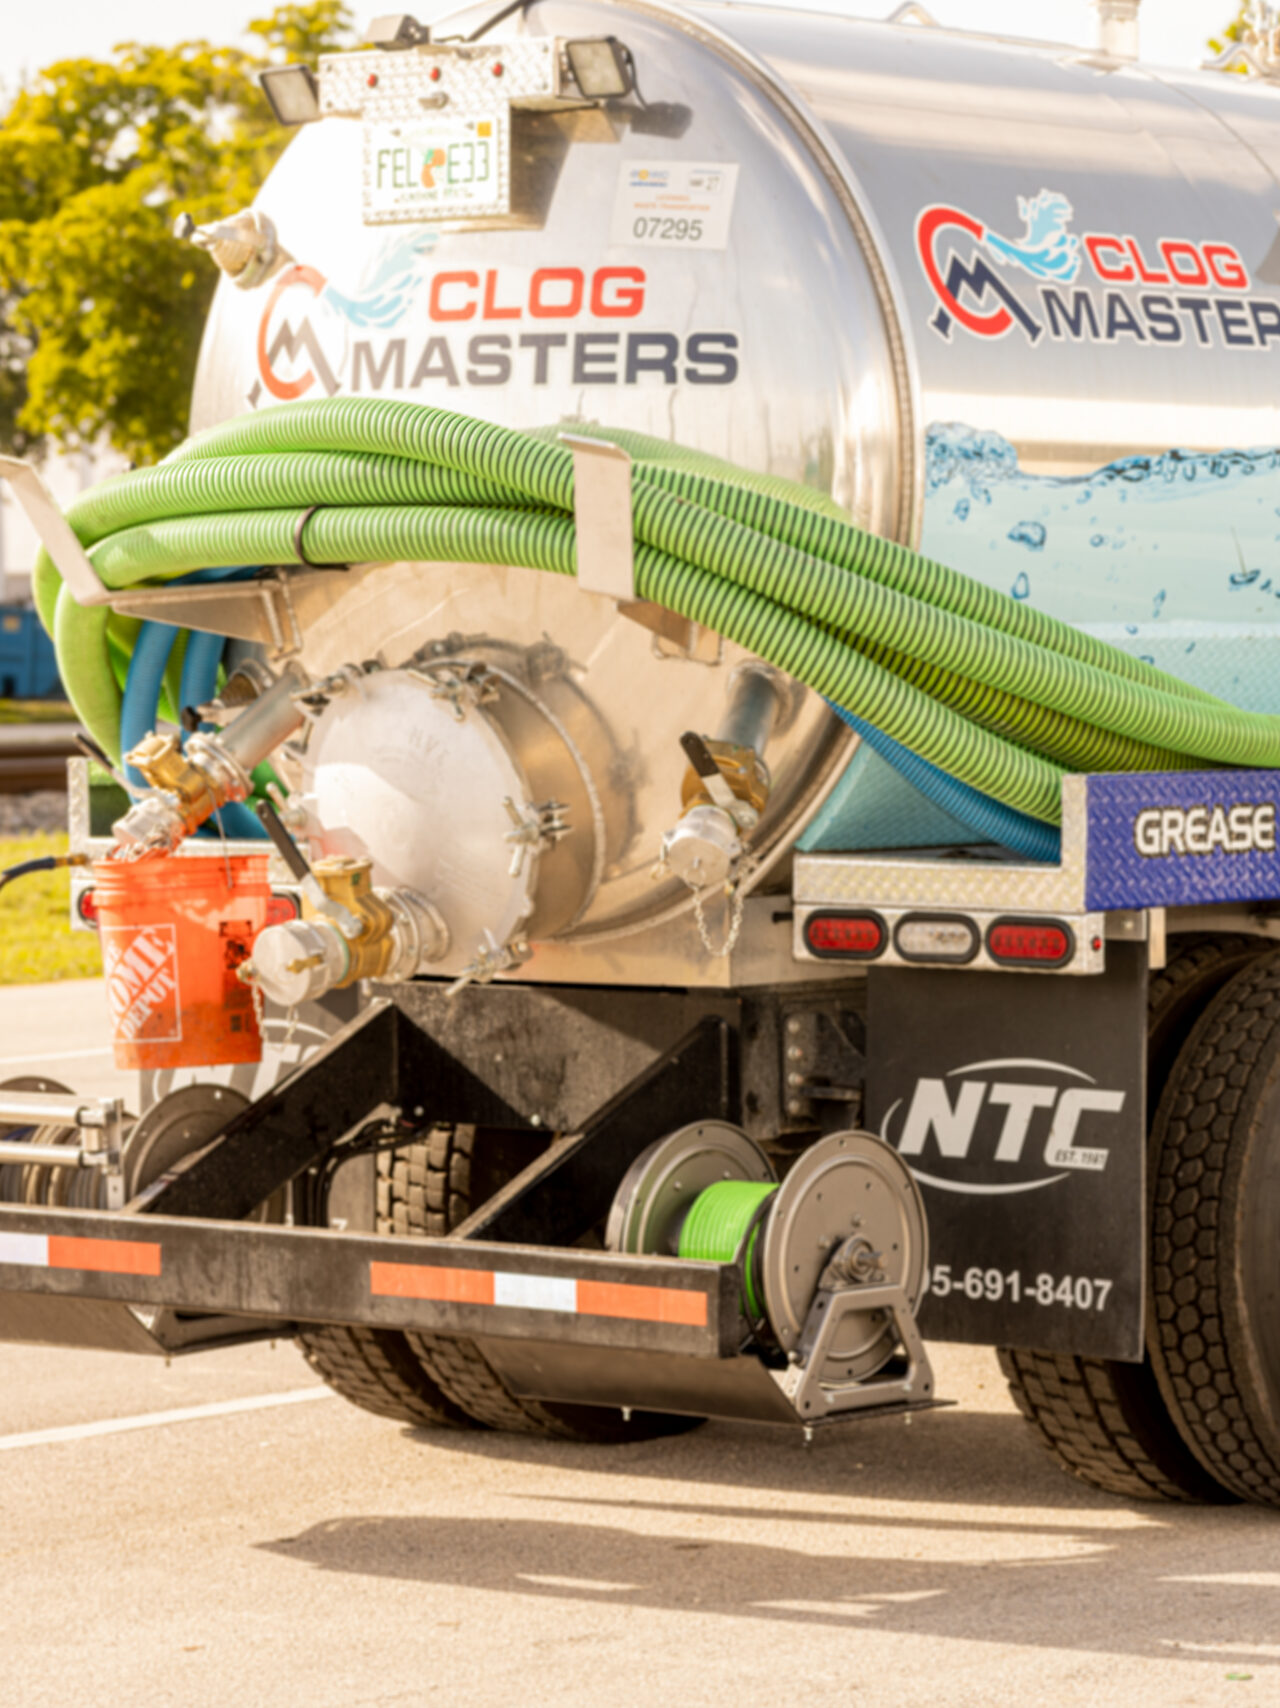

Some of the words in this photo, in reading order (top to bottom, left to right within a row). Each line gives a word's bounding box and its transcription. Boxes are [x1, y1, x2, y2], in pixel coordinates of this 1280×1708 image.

[632, 216, 704, 241] 07295
[1084, 235, 1250, 289] CLOG
[429, 266, 647, 322] CLOG
[350, 331, 739, 392] MASTERS
[1135, 805, 1275, 856] GREASE
[897, 1077, 1126, 1171] NTC
[923, 1264, 1113, 1312] 5-691-8407
